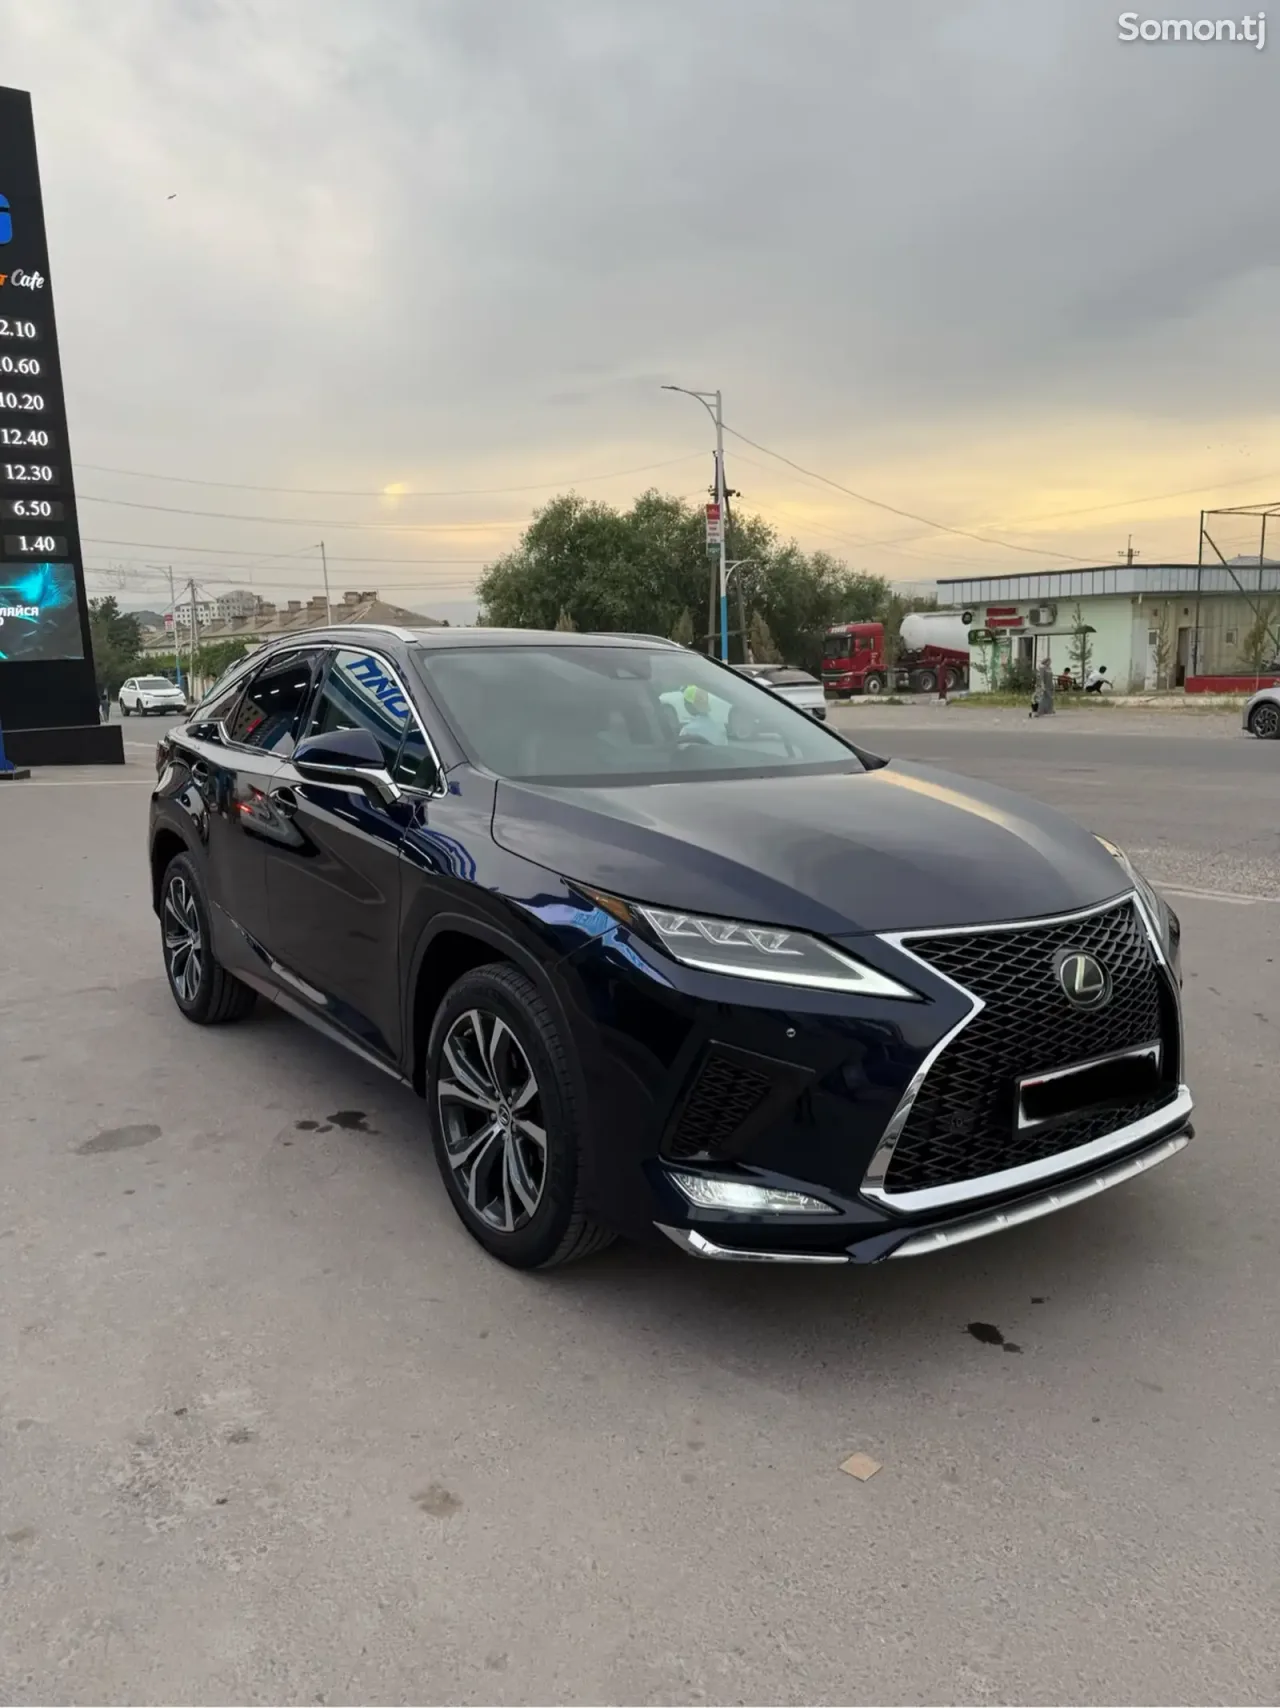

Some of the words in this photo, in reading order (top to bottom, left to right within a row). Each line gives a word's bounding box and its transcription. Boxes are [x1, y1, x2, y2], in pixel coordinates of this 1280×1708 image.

[11, 268, 45, 291] Cafe
[0, 356, 40, 375] 0.60
[1, 428, 48, 446] 12.40
[5, 464, 52, 481] 12.30
[14, 500, 51, 517] 6.50
[19, 535, 55, 551] 1.40
